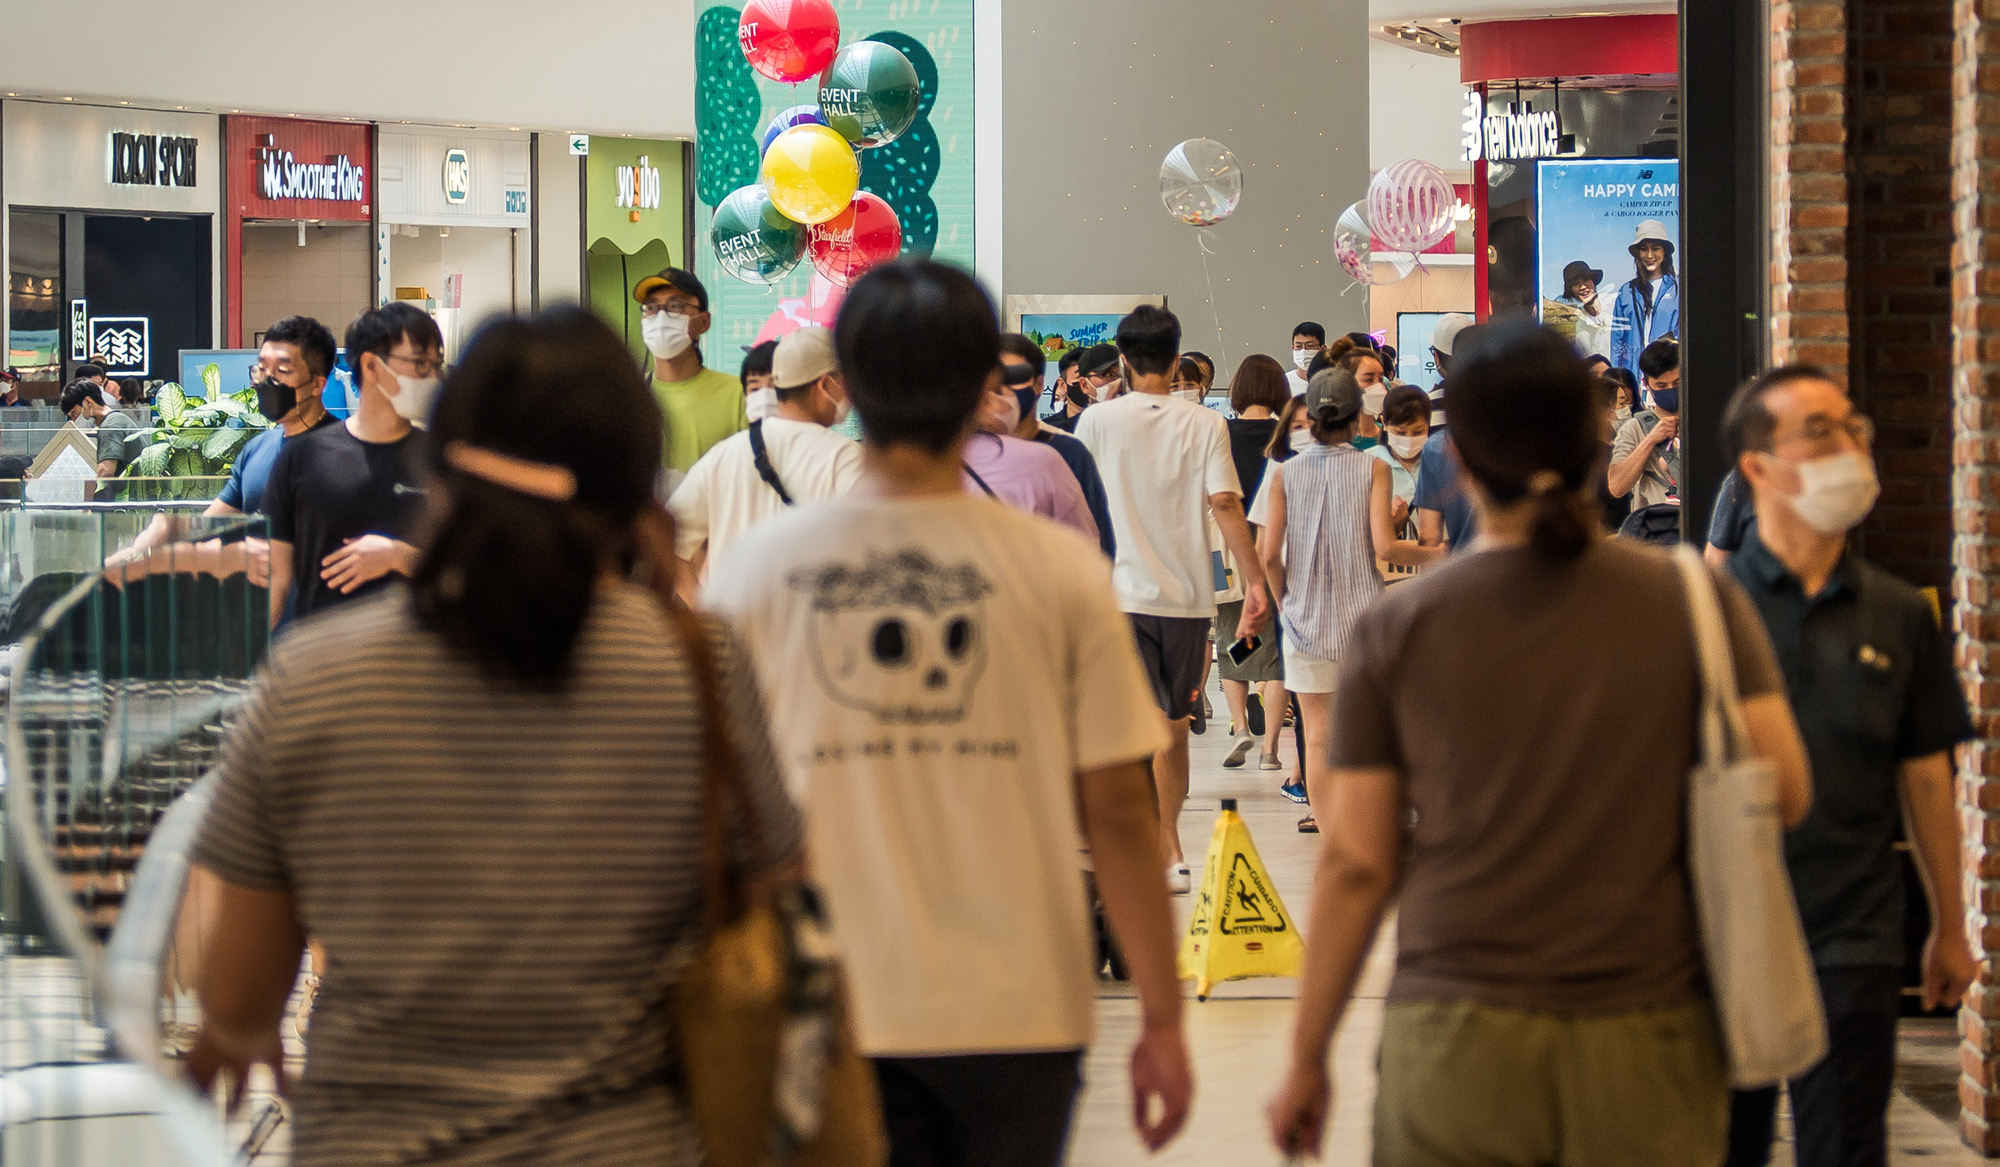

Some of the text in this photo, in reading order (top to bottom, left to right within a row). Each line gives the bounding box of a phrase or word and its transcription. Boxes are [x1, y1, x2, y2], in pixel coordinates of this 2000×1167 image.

[821, 87, 861, 103] EVENT
[823, 102, 857, 117] HALL
[1483, 100, 1558, 161] new balance
[112, 131, 198, 187] KOLON SPORT
[283, 151, 336, 199] SMOOTHIE
[448, 161, 467, 193] HAS
[617, 154, 660, 222] yogibo
[1583, 183, 1680, 198] HAPPY CAM
[1619, 200, 1648, 208] CAMPER
[719, 228, 761, 255] EVENT
[811, 223, 852, 250] Starfield
[726, 245, 766, 267] HALL
[1069, 322, 1108, 340] SUMMER
[1223, 870, 1236, 916] CAUTION
[1249, 869, 1279, 913] CUIDADO
